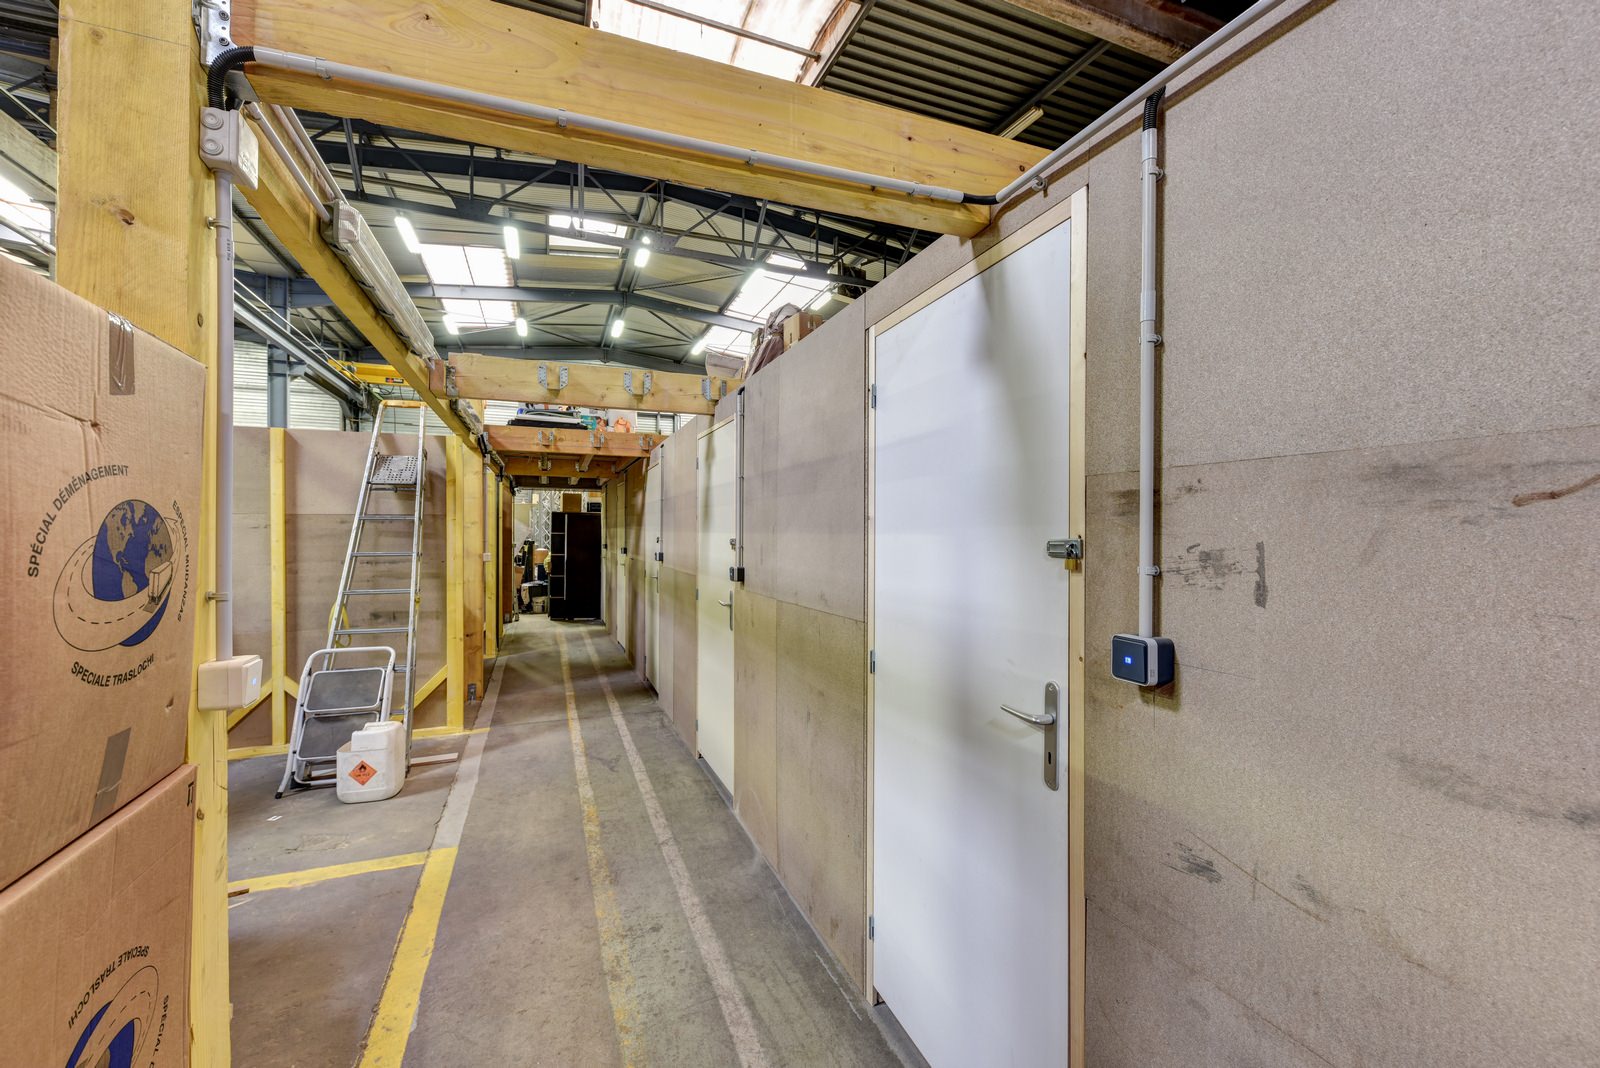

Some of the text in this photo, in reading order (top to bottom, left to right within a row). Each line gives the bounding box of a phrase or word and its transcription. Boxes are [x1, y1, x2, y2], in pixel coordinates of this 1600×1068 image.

[28, 464, 129, 578] SPÉCIAL DÉMÉNAGEMENT
[172, 500, 189, 622] ESPECIAL MUDANZAS
[71, 653, 155, 687] SPECIALE TRASLOCHI
[68, 945, 150, 1029] SPECIALE TRASLOCHI
